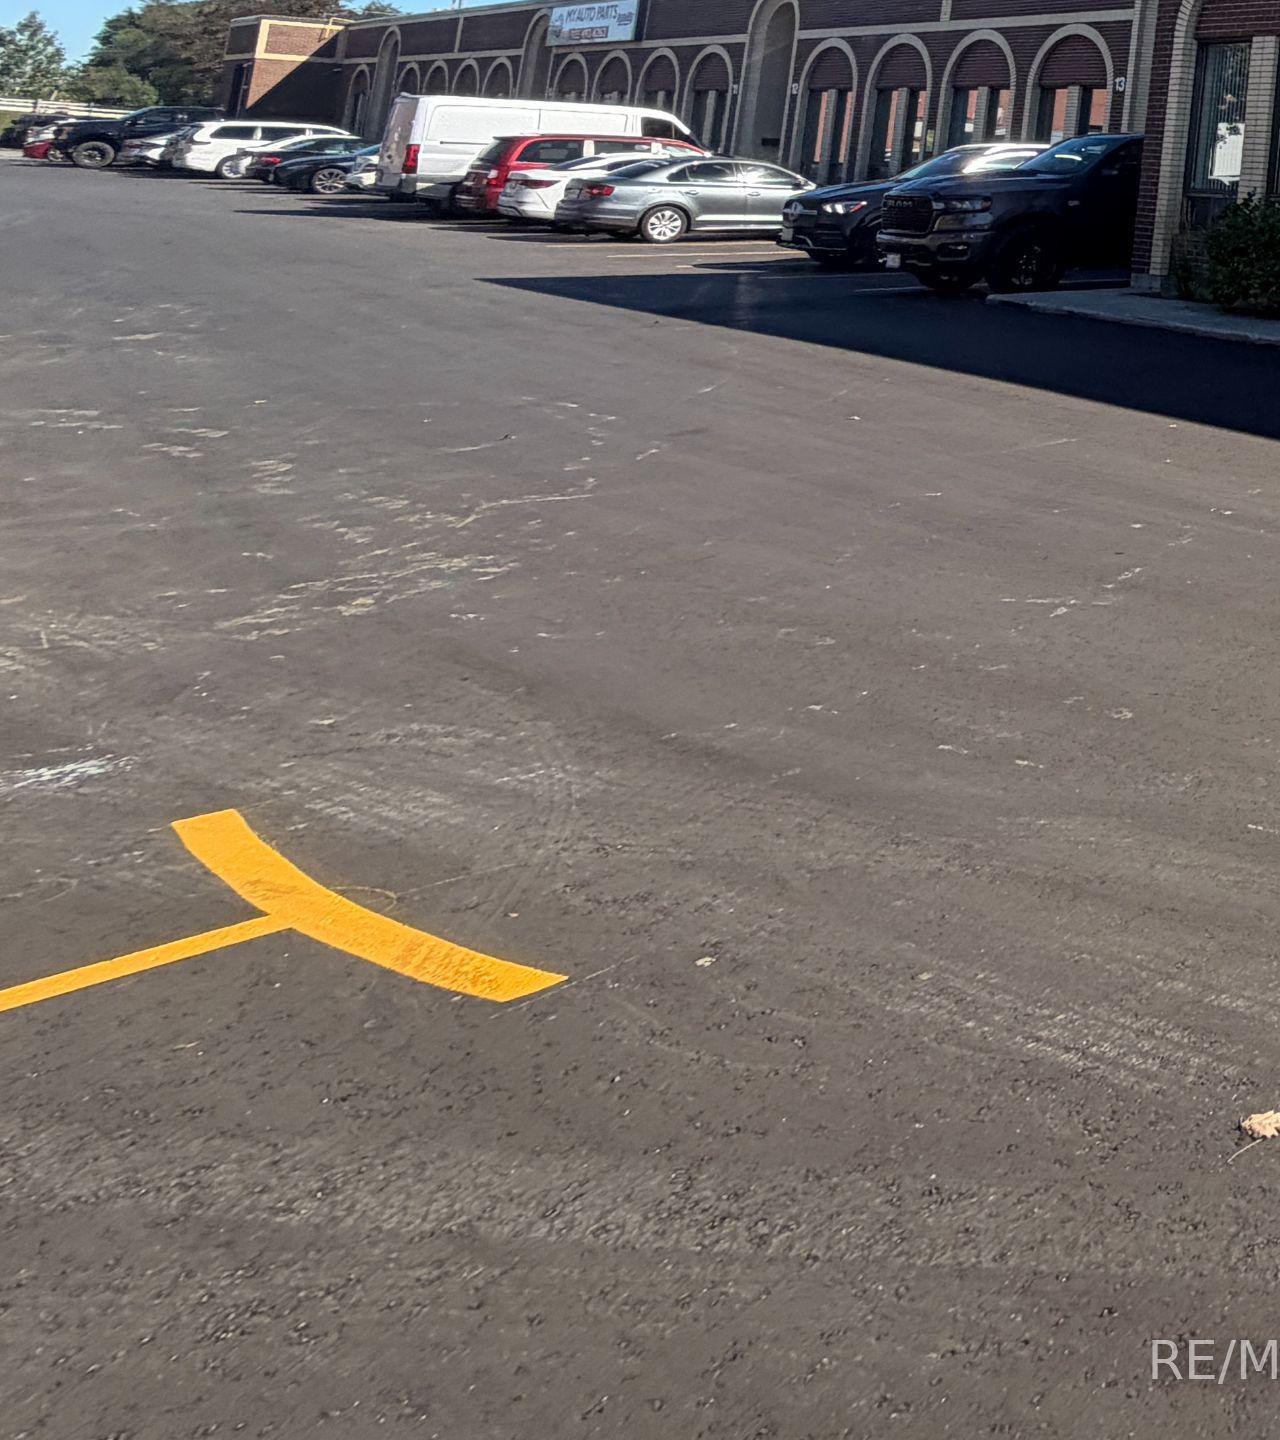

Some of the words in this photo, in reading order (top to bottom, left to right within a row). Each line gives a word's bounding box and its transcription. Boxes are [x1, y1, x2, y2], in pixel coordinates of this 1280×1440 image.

[576, 6, 596, 22] AUTO
[596, 4, 619, 20] PARTS
[1114, 76, 1126, 92] 13
